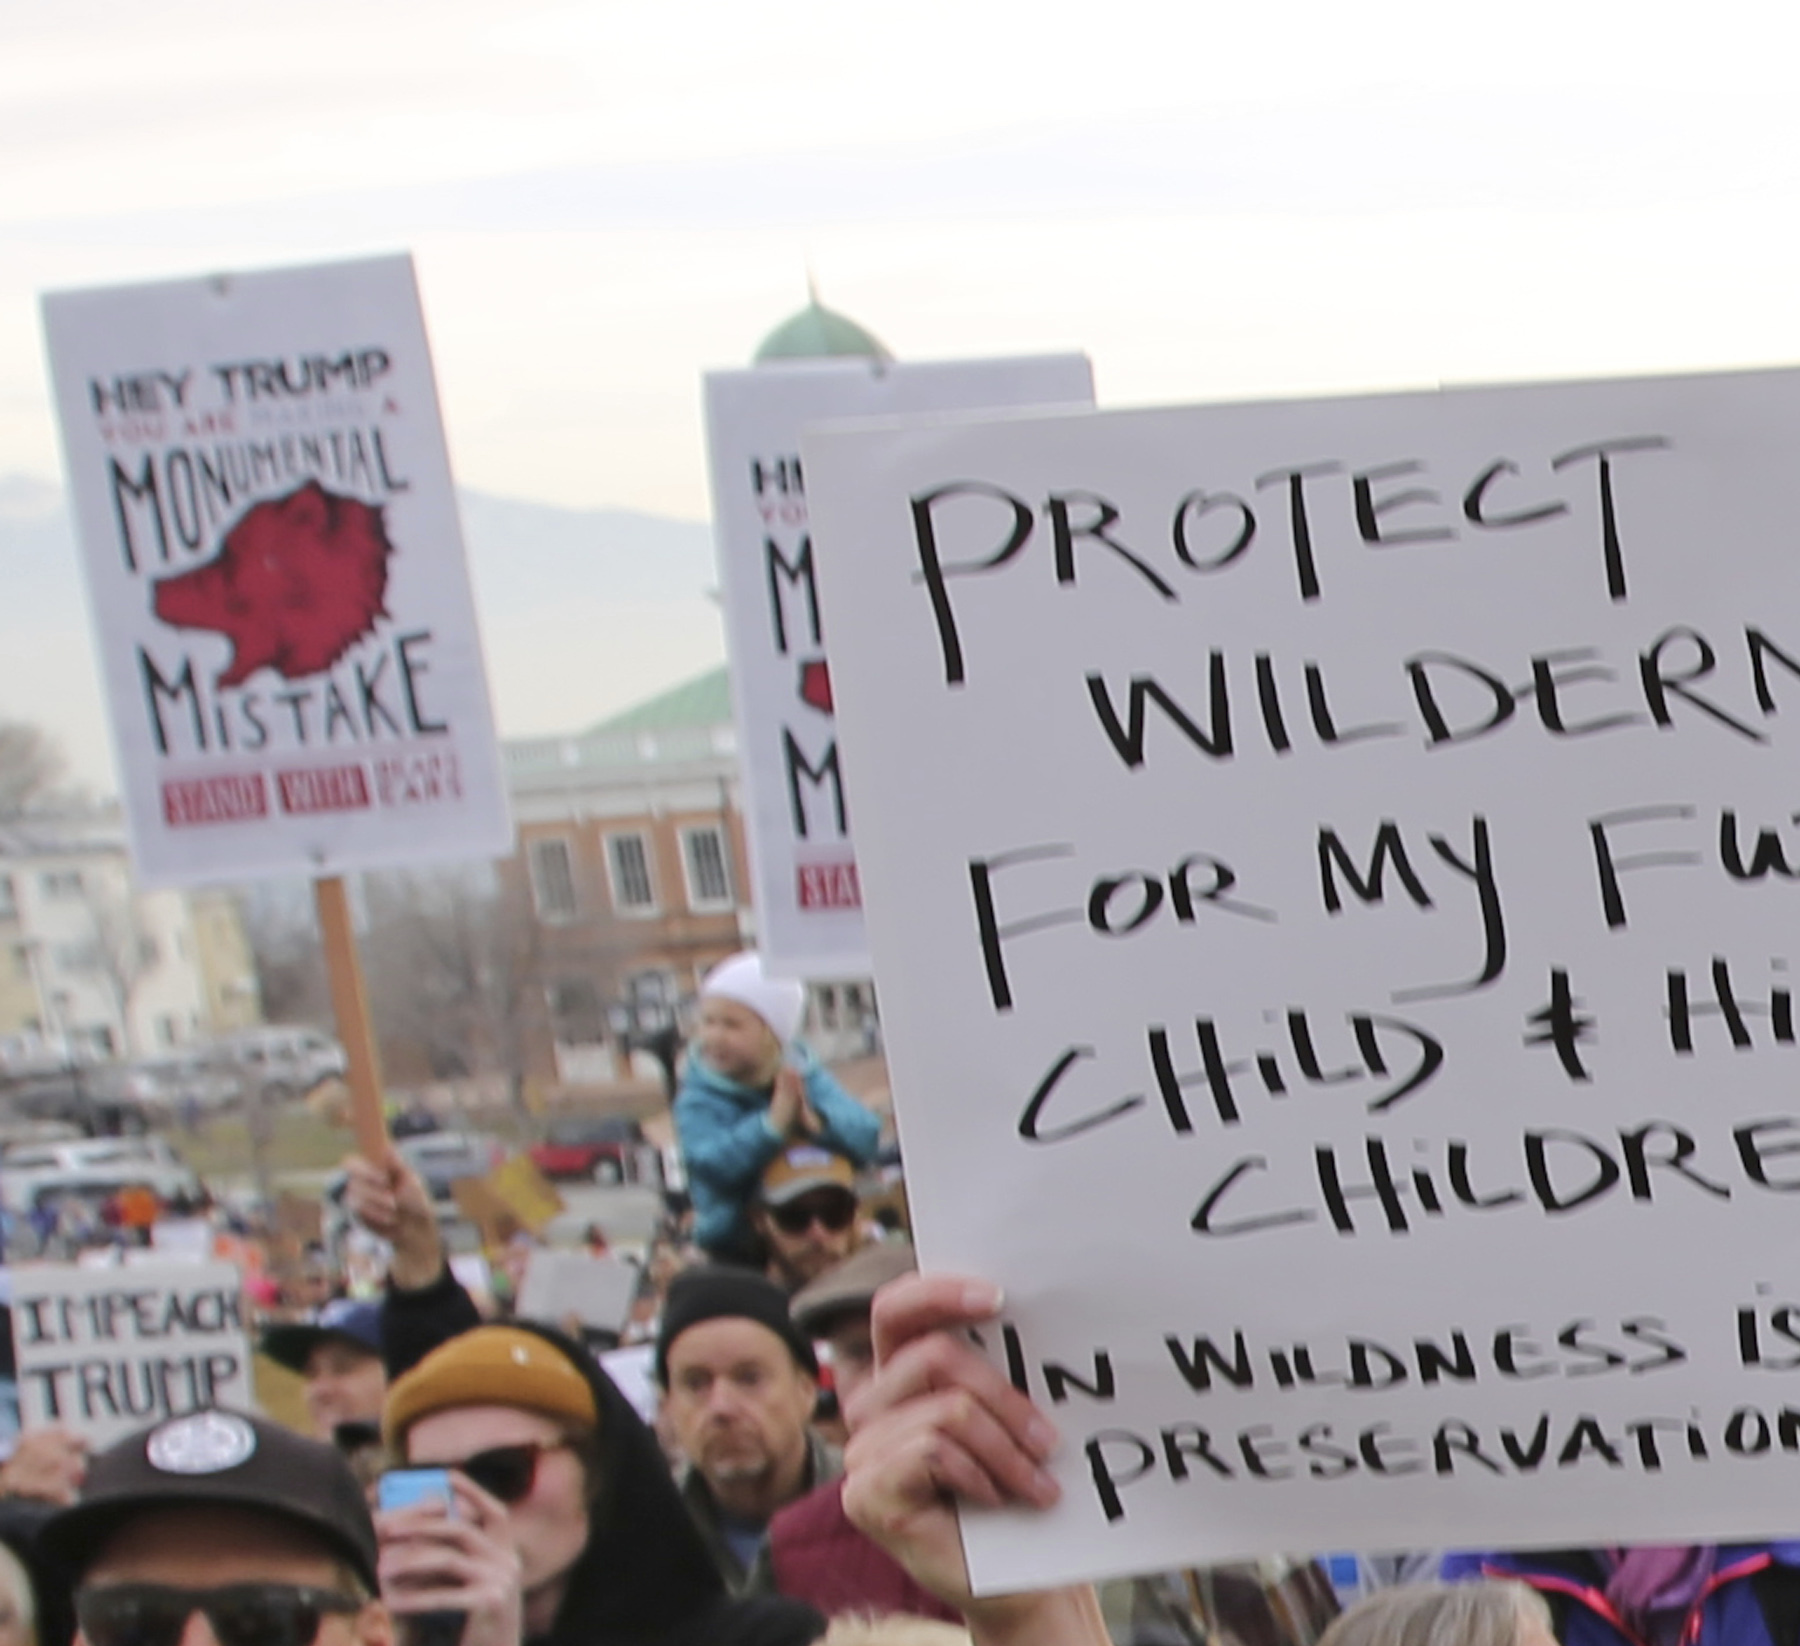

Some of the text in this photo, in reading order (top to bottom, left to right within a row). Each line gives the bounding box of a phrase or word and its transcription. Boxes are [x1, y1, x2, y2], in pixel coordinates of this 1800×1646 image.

[88, 348, 392, 414] HEY TRUMP
[110, 426, 409, 573] MONUMENTAL
[911, 434, 1674, 689] PROTECT
[969, 840, 1279, 1012] FOR
[18, 1288, 241, 1346] IMPEACH
[24, 1354, 239, 1420] TRUMP
[1164, 1318, 1688, 1393] WILDNESS
